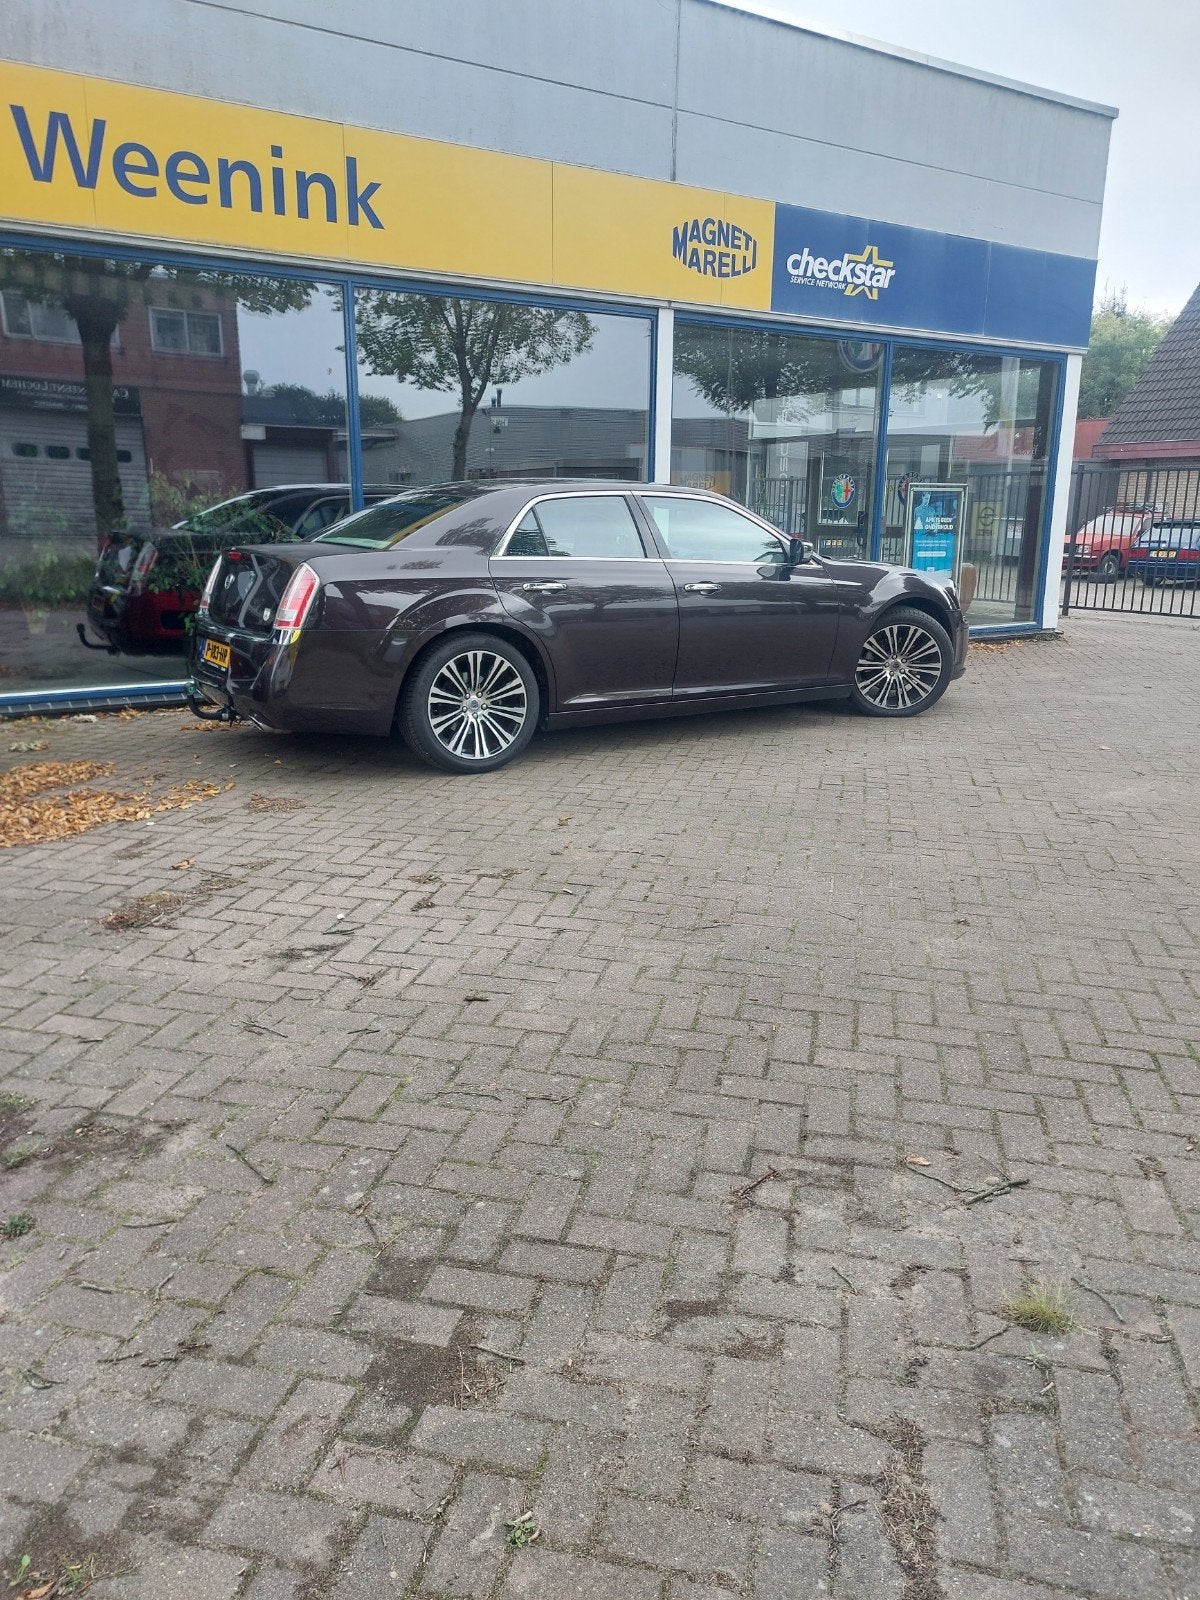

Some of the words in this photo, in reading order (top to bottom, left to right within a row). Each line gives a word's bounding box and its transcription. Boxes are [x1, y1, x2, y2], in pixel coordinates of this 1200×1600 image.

[10, 104, 385, 230] Weenink
[672, 217, 757, 259] MAGNETI
[672, 238, 757, 278] MARELLI
[786, 247, 896, 289] checkstar
[789, 275, 815, 287] SERVICE
[815, 279, 847, 290] NETWORK
